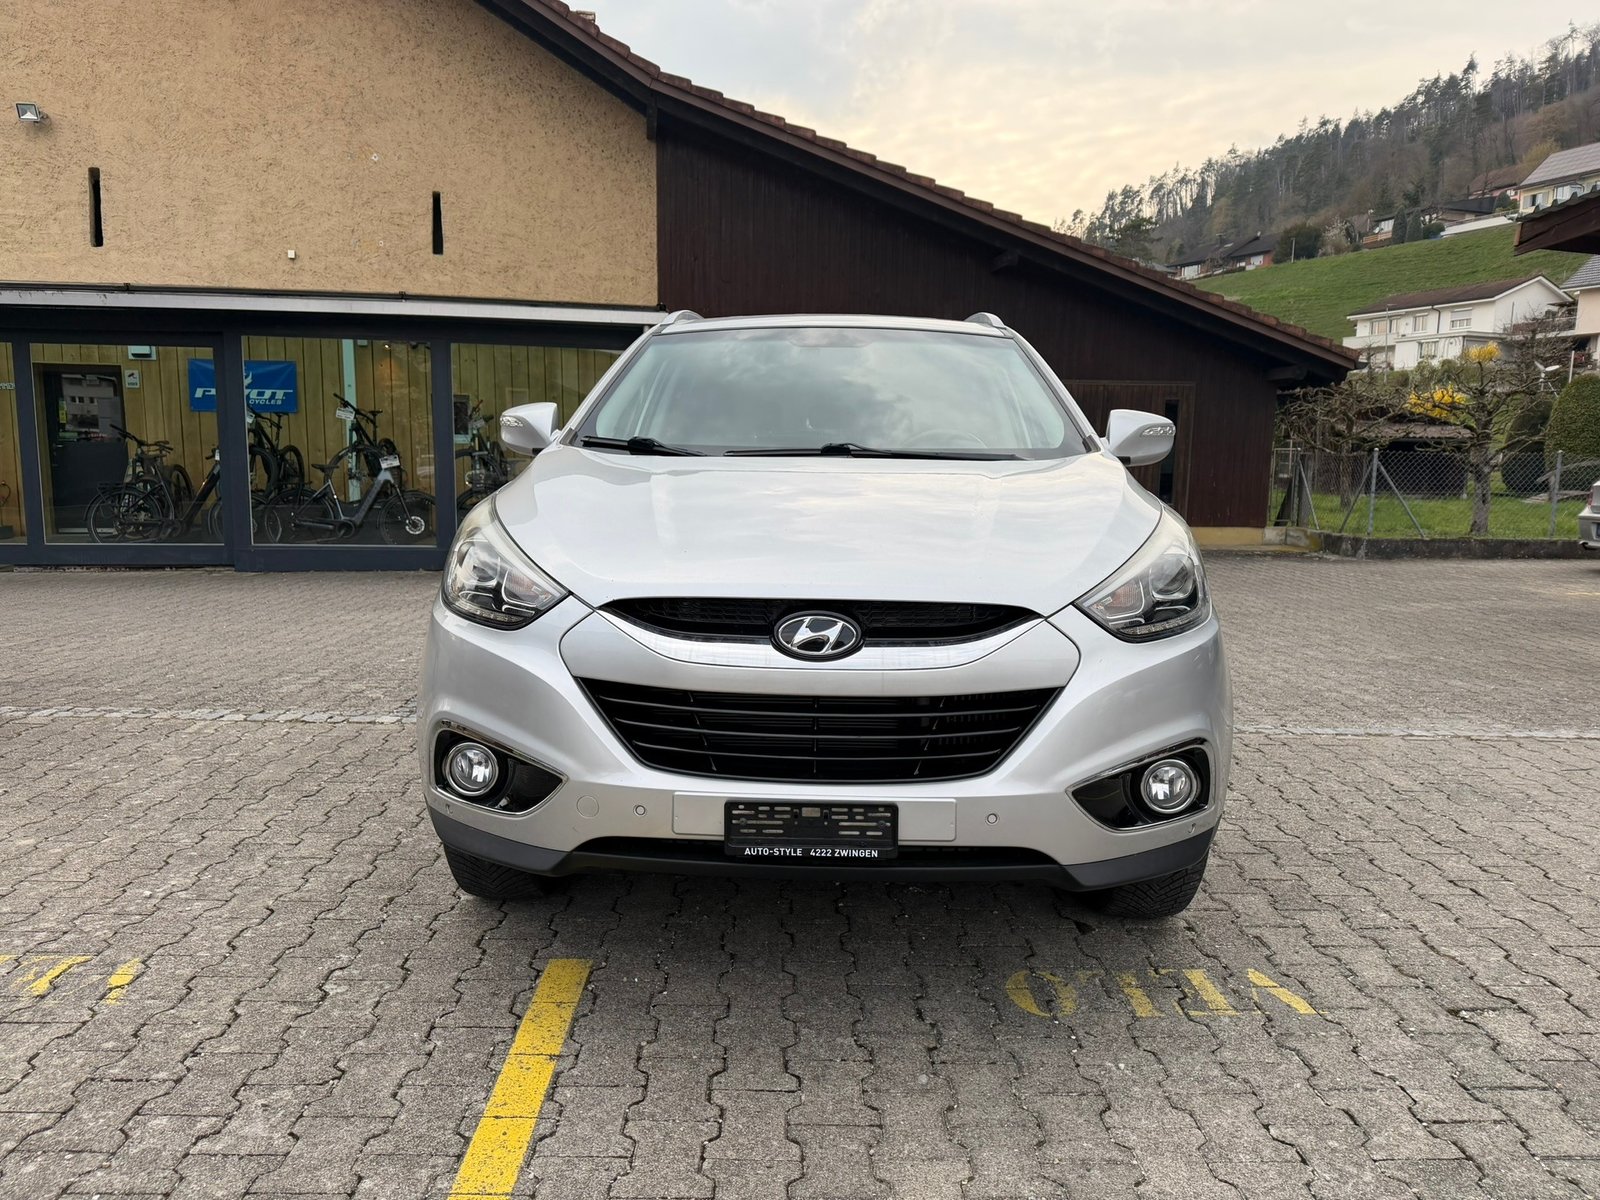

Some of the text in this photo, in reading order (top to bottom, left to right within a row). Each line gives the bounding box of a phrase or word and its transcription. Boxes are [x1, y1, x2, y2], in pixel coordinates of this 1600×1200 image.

[744, 847, 878, 858] AUTO-STYLE 4222 ZWINGEN
